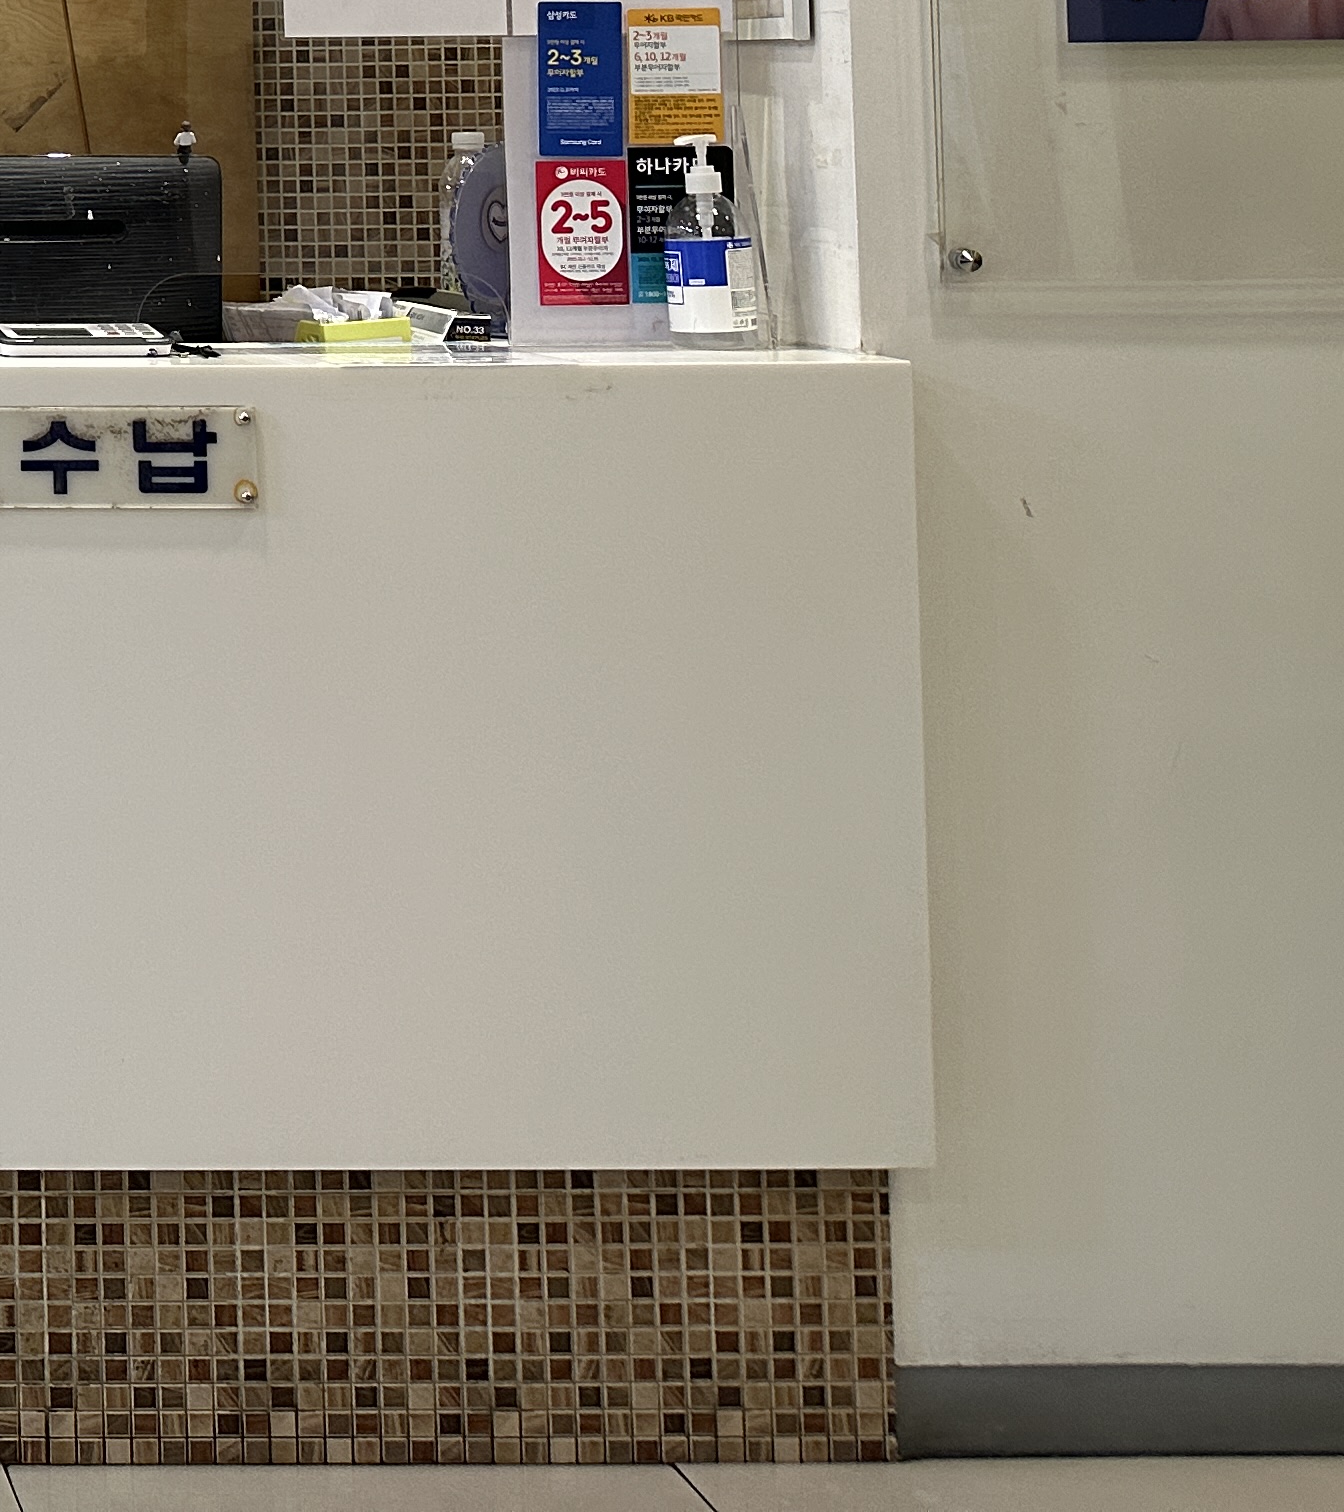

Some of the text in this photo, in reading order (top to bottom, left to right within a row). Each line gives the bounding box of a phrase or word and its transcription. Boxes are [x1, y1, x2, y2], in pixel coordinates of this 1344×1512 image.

[547, 11, 577, 20] 삼성카드
[551, 200, 613, 234] 2~5
[456, 326, 484, 334] NO.33
[20, 419, 218, 495] 수납
